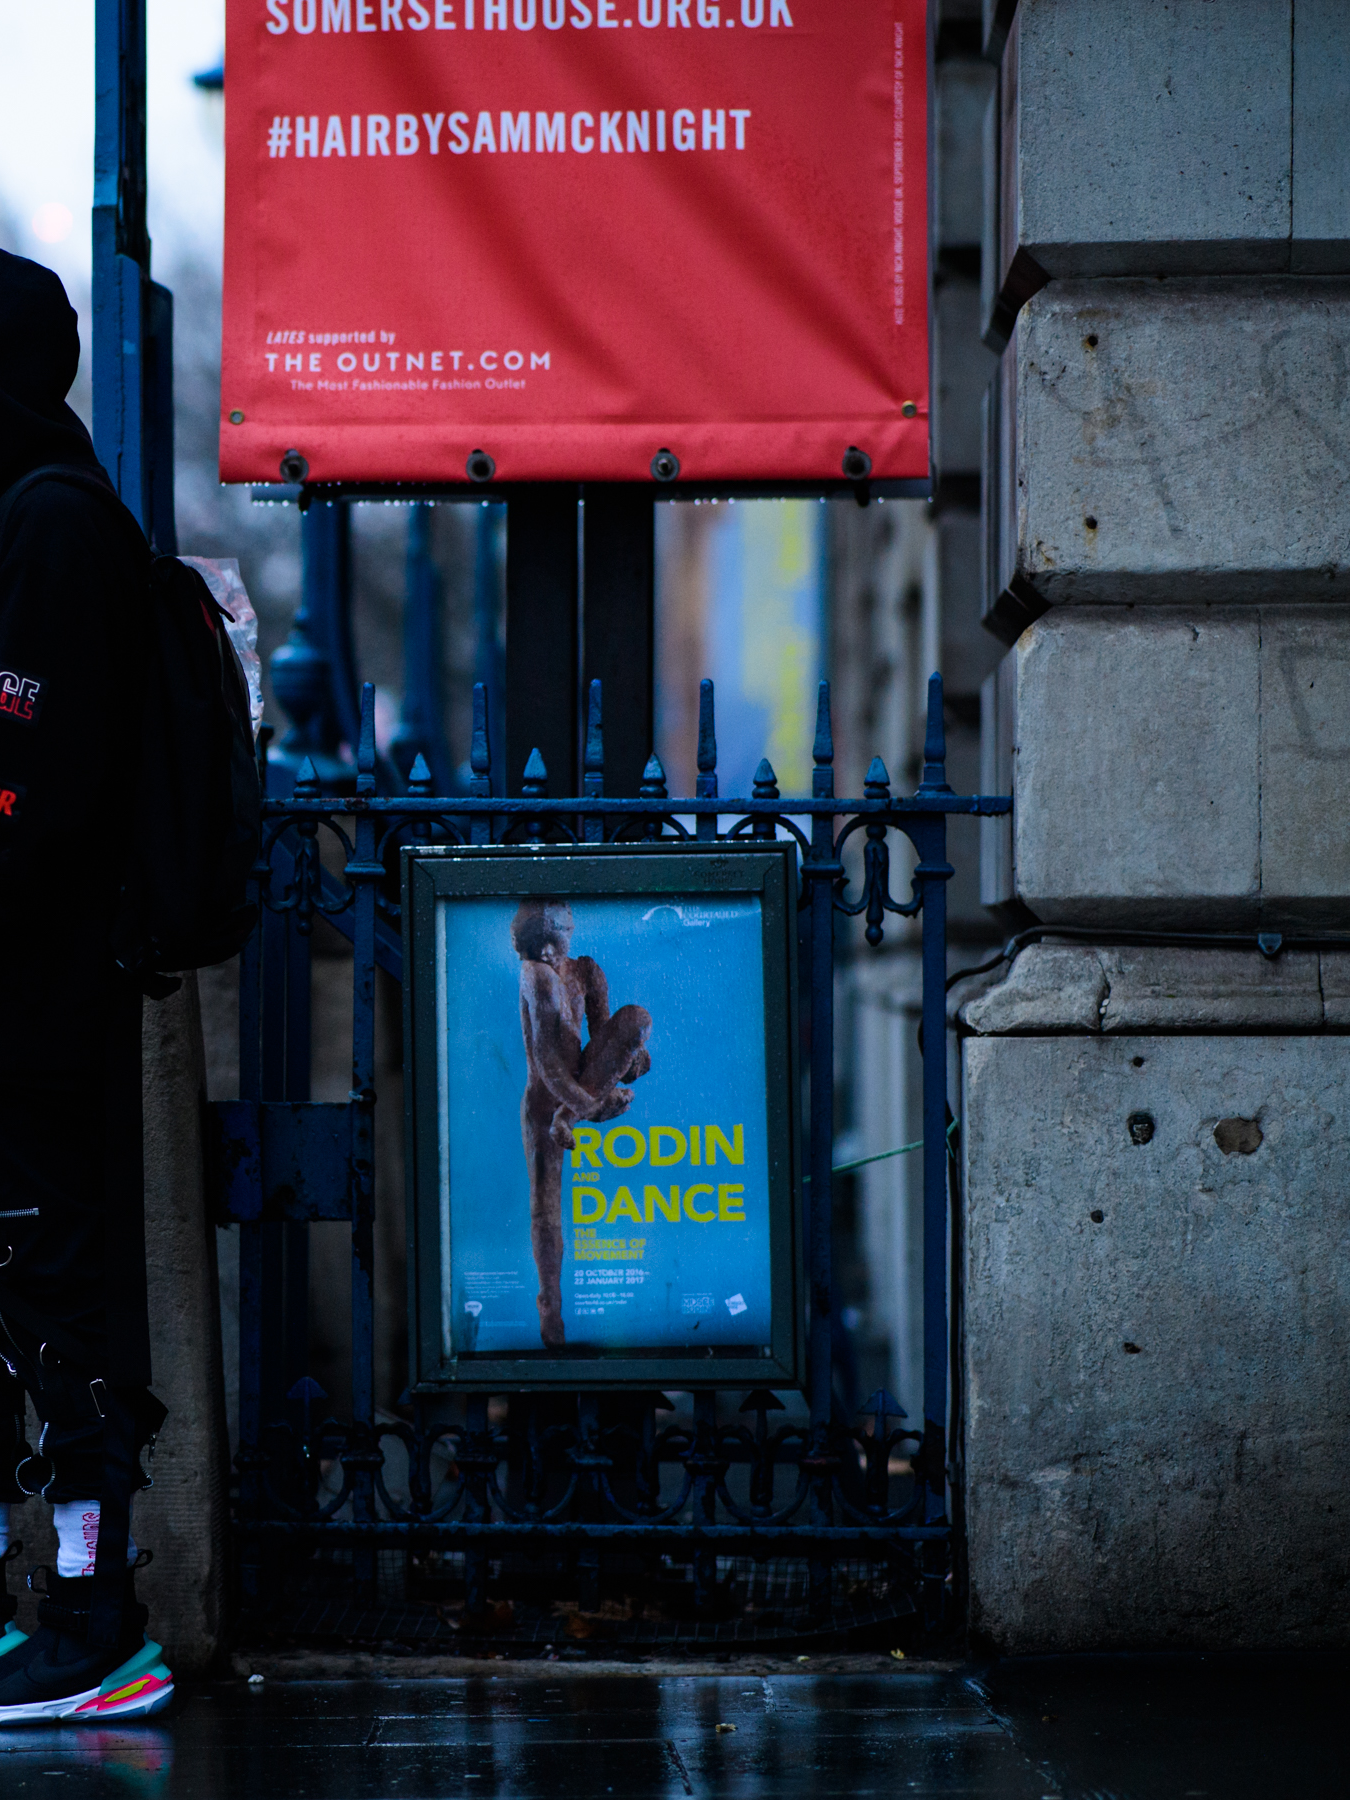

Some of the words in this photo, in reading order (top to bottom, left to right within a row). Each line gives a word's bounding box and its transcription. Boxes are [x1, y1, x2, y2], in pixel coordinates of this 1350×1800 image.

[265, 0, 794, 35] SOMERSETHOUSE.ORG.UK
[267, 109, 751, 158] #HAIRBYSAMMCKNIGHT
[266, 331, 305, 344] LATES
[308, 331, 375, 346] supported
[380, 330, 396, 345] by
[265, 353, 322, 372] THE
[336, 351, 550, 372] OUTNET.COM
[290, 379, 313, 391] The
[317, 379, 348, 391] Most
[352, 379, 428, 391] Fashionable
[432, 378, 481, 391] Fashion
[485, 377, 526, 390] Outlet
[571, 1124, 744, 1168] RODIN
[572, 1172, 600, 1182] AND
[572, 1184, 746, 1224] DANCE
[574, 1228, 597, 1238] THE
[574, 1239, 626, 1250] ESSENCE
[629, 1239, 646, 1249] OF
[574, 1250, 645, 1260] MOVEMENT
[586, 1277, 624, 1286] JANUARY
